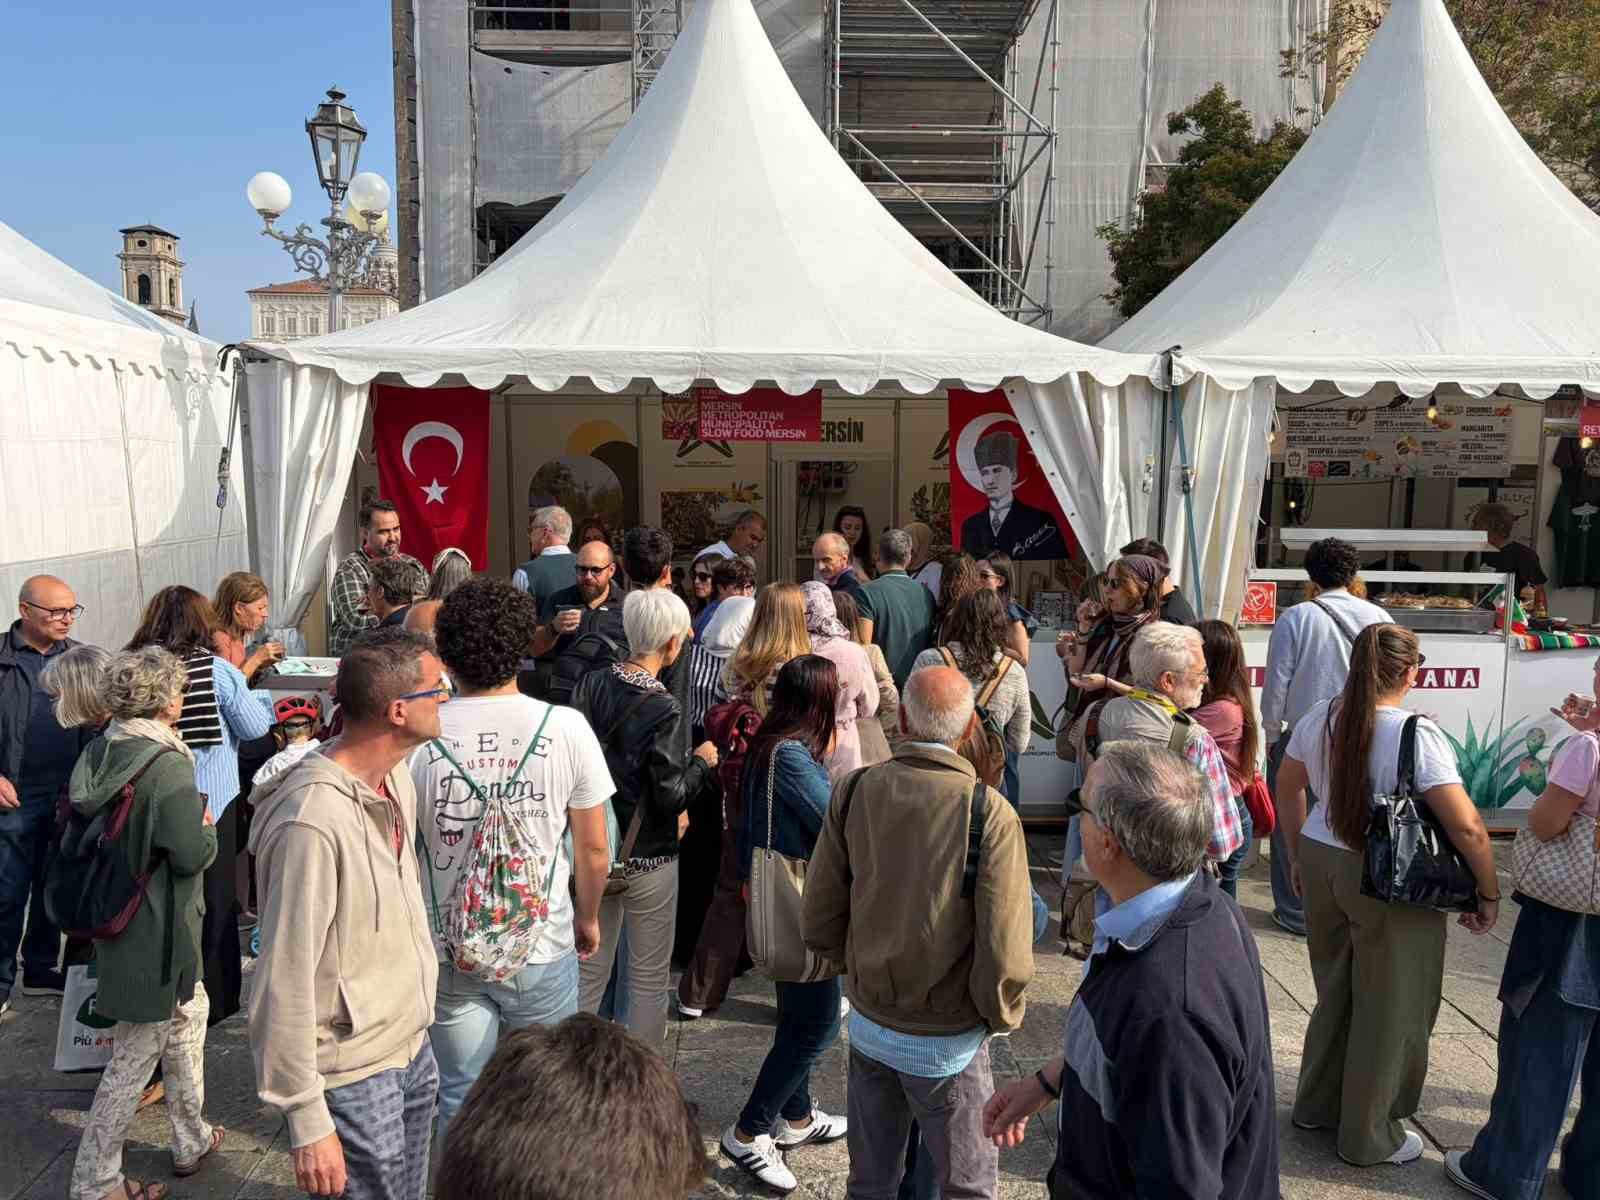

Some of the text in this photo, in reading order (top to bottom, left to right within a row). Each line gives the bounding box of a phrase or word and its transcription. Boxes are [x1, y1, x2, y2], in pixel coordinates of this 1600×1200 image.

[702, 401, 742, 411] MERSIN
[702, 410, 784, 420] METROPOLITAN
[702, 419, 775, 429] MUNICIPALITY
[701, 428, 807, 438] SLOW FOOD MERSIN
[477, 731, 499, 753] E
